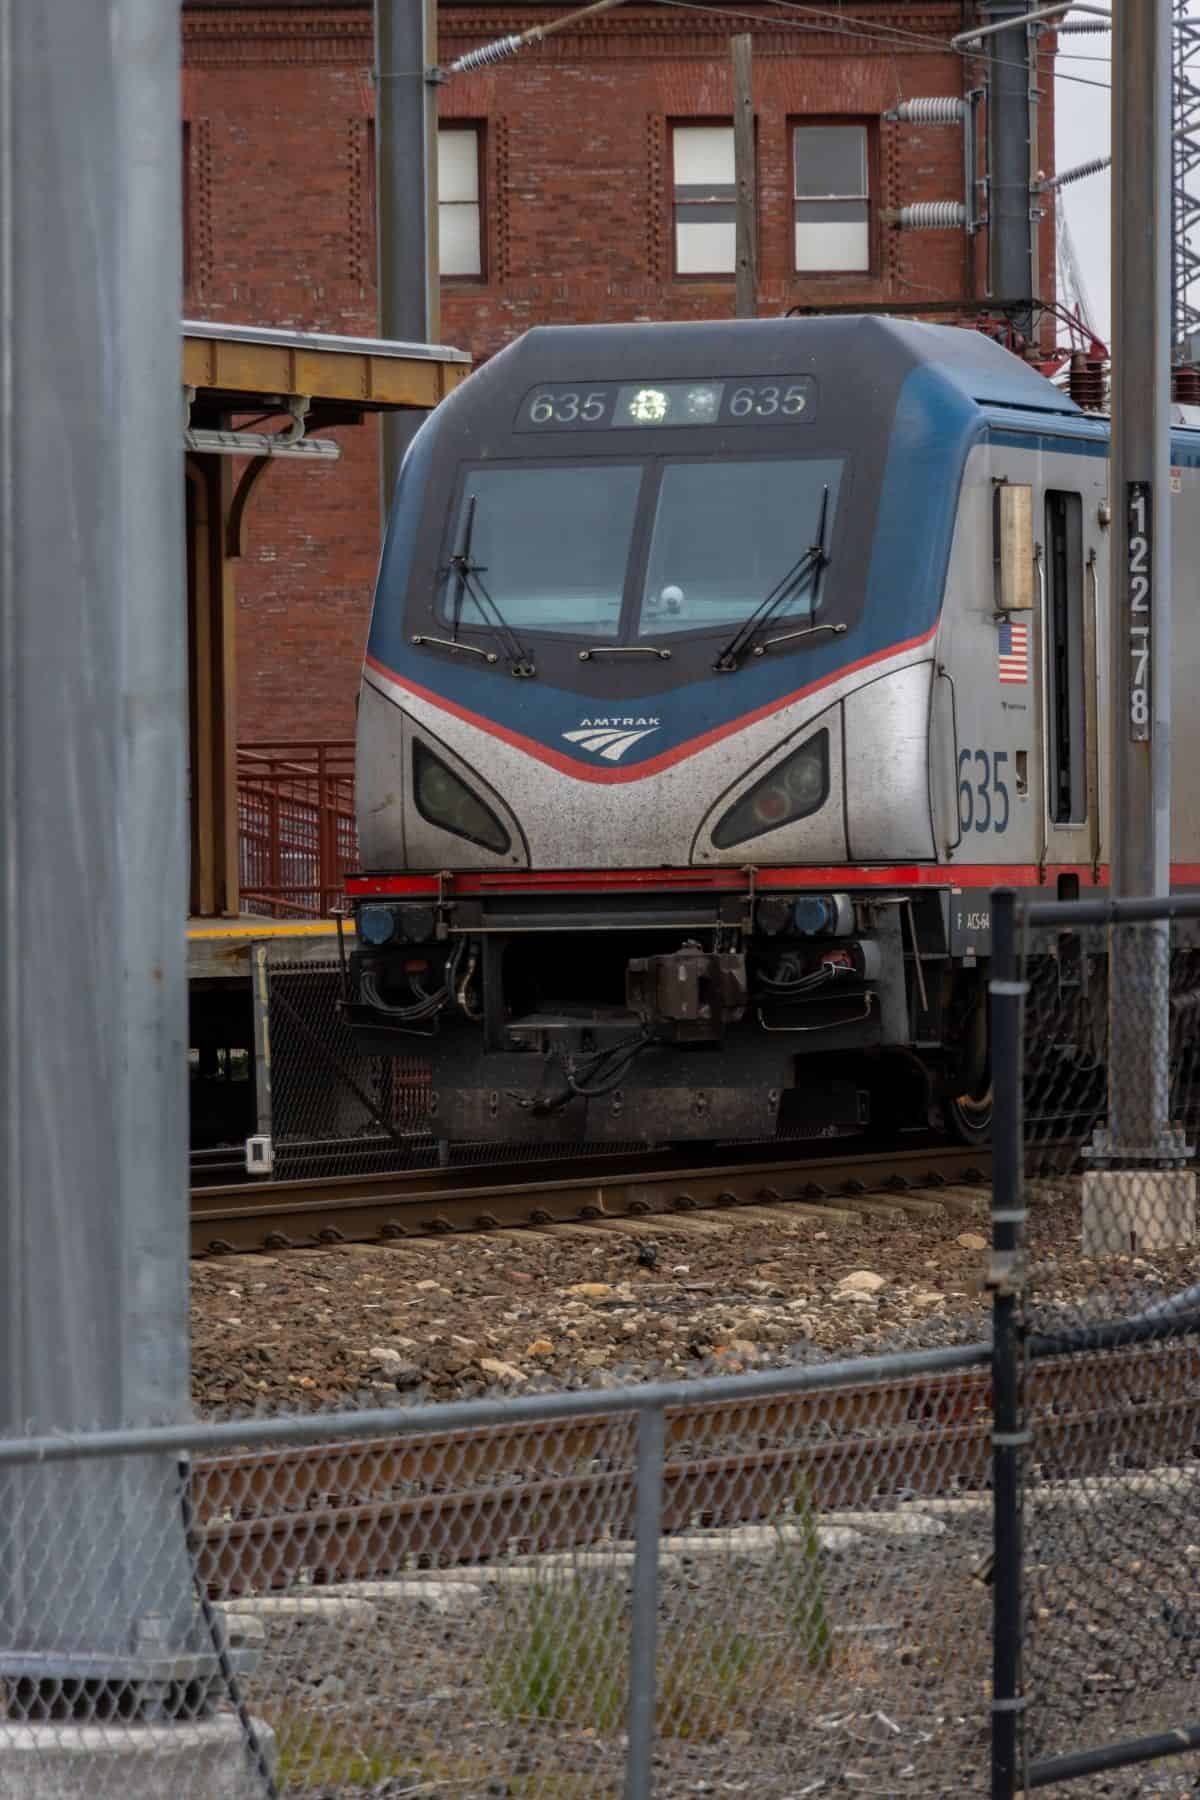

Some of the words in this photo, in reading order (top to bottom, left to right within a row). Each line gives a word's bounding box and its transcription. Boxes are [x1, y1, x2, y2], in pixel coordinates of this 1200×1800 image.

[530, 392, 607, 423] 635
[729, 386, 808, 416] 635
[580, 718, 660, 726] AMTRAK
[959, 749, 1009, 833] 635
